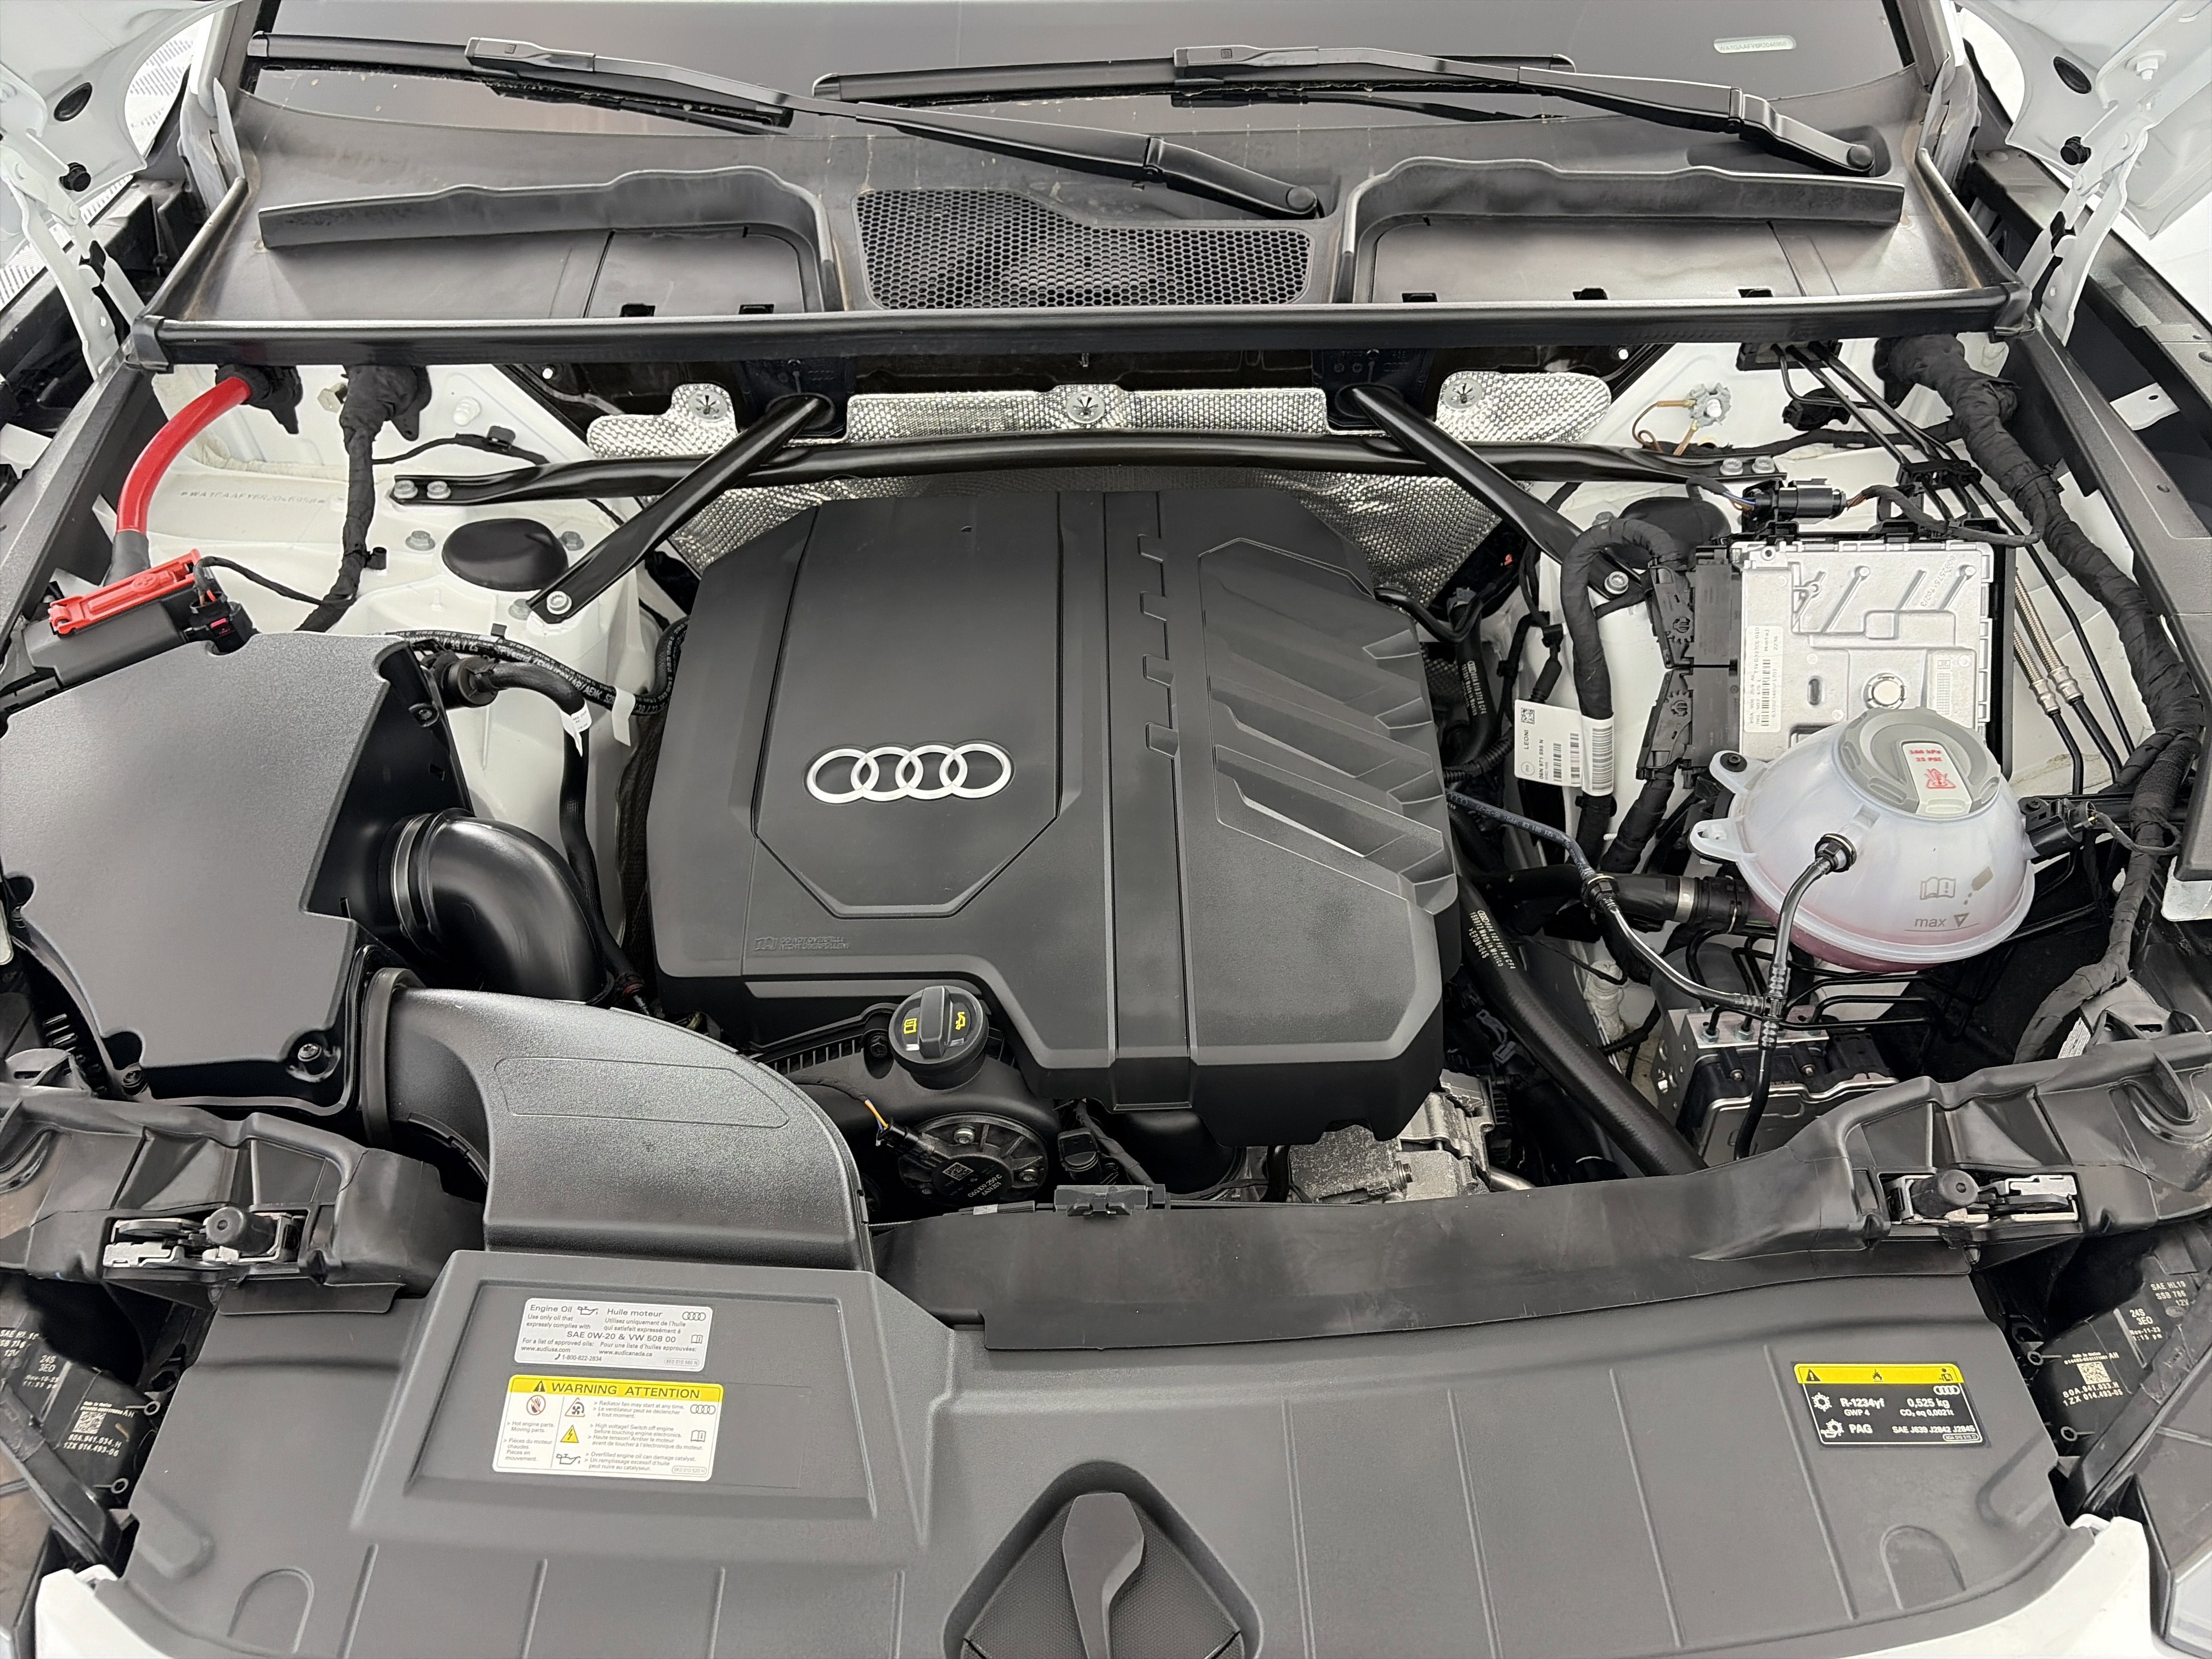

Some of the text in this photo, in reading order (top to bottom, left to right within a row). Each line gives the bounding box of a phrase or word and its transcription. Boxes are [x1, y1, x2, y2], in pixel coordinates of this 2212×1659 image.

[1915, 917, 1946, 928] max
[1479, 929, 1490, 943] Made
[1490, 948, 1504, 967] Mexico
[2151, 1282, 2167, 1291] SAE
[2155, 1291, 2172, 1300] SSB
[2129, 1308, 2146, 1318] 24S
[0, 1329, 16, 1338] SAE
[4, 1349, 20, 1357] 12V
[551, 1382, 701, 1399] WARNING ATTENTION
[1840, 1398, 1884, 1408] R-1234yf
[1907, 1398, 1950, 1408] 0,525 kg
[1849, 1424, 1872, 1433] PAG
